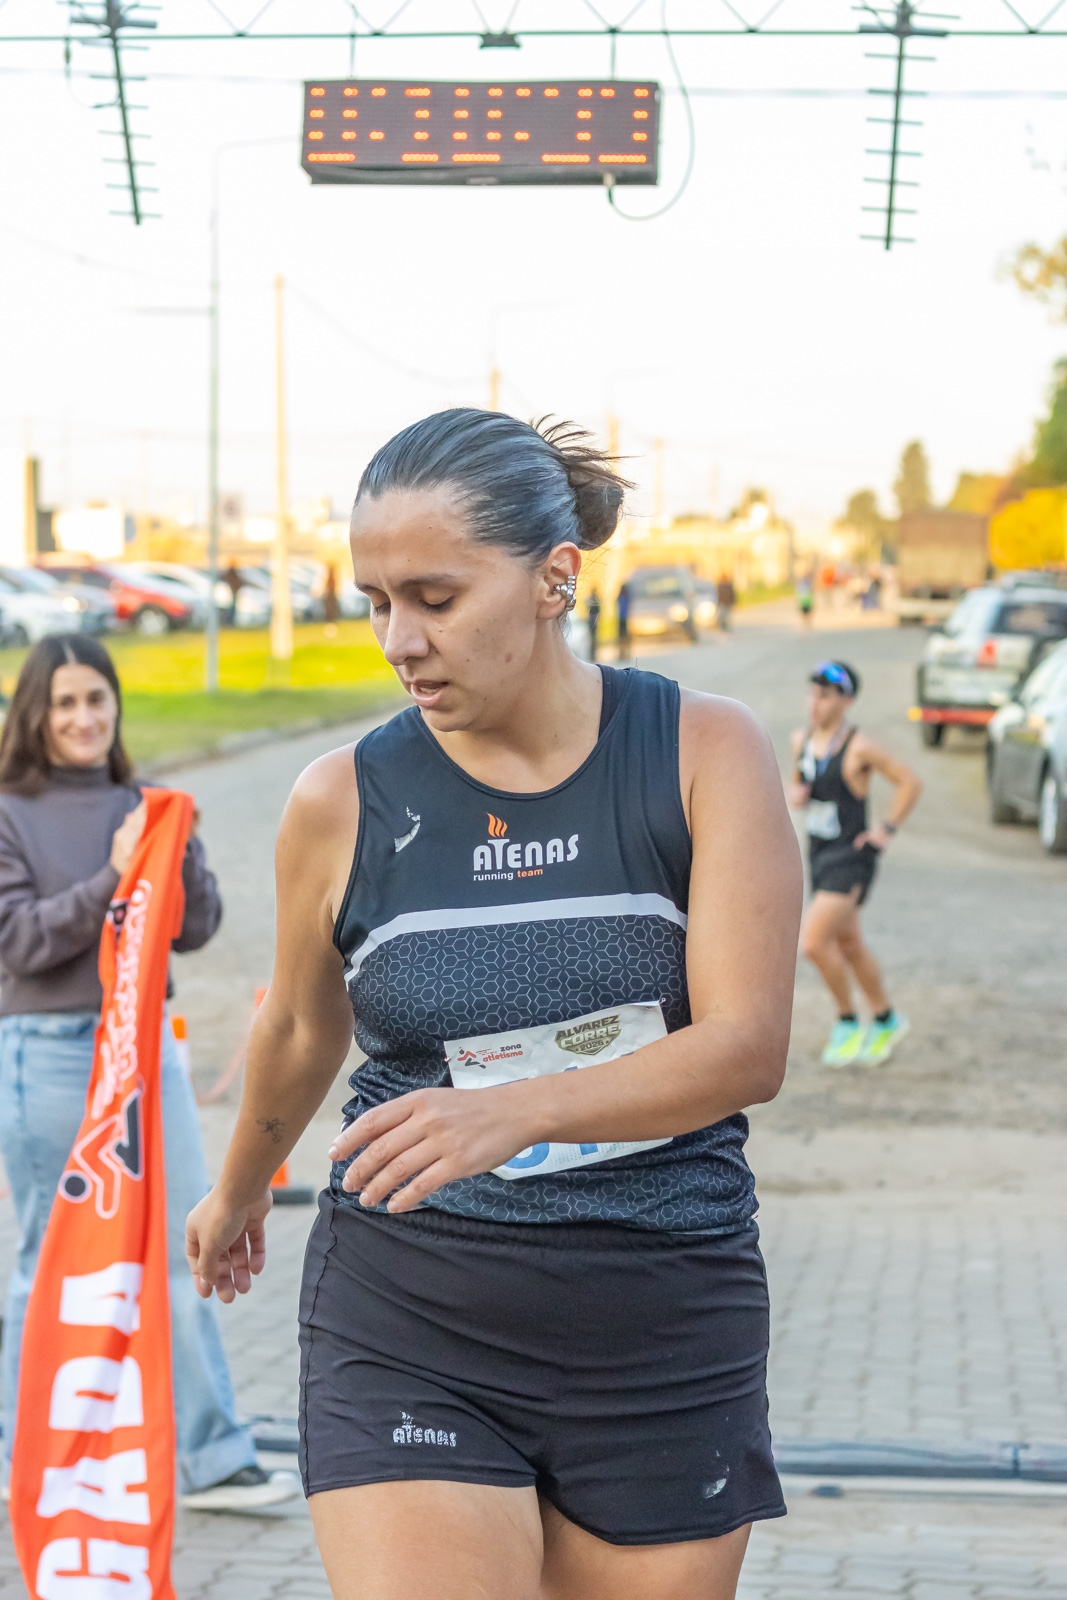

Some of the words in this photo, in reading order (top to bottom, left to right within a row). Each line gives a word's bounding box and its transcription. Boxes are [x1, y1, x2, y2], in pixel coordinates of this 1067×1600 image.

[473, 834, 579, 871] ATENAS
[473, 871, 514, 882] running
[517, 868, 544, 878] team
[556, 1014, 620, 1040] ALVAREZ
[560, 1023, 620, 1049] CORRE
[482, 1050, 524, 1063] atletismo
[500, 1043, 522, 1052] zona
